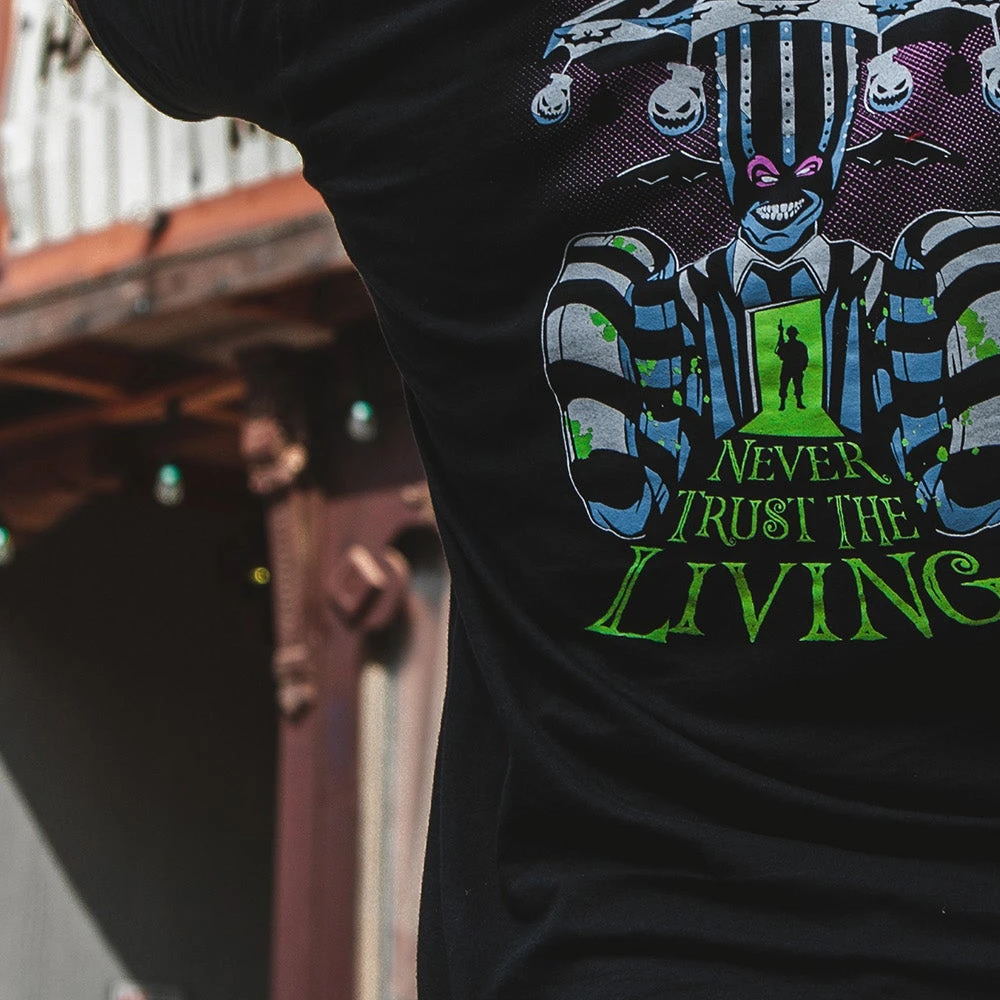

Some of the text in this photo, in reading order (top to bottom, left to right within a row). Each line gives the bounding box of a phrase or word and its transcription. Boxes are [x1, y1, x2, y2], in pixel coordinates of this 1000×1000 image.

[707, 439, 892, 485] NEVER
[667, 489, 920, 549] TRUST THE
